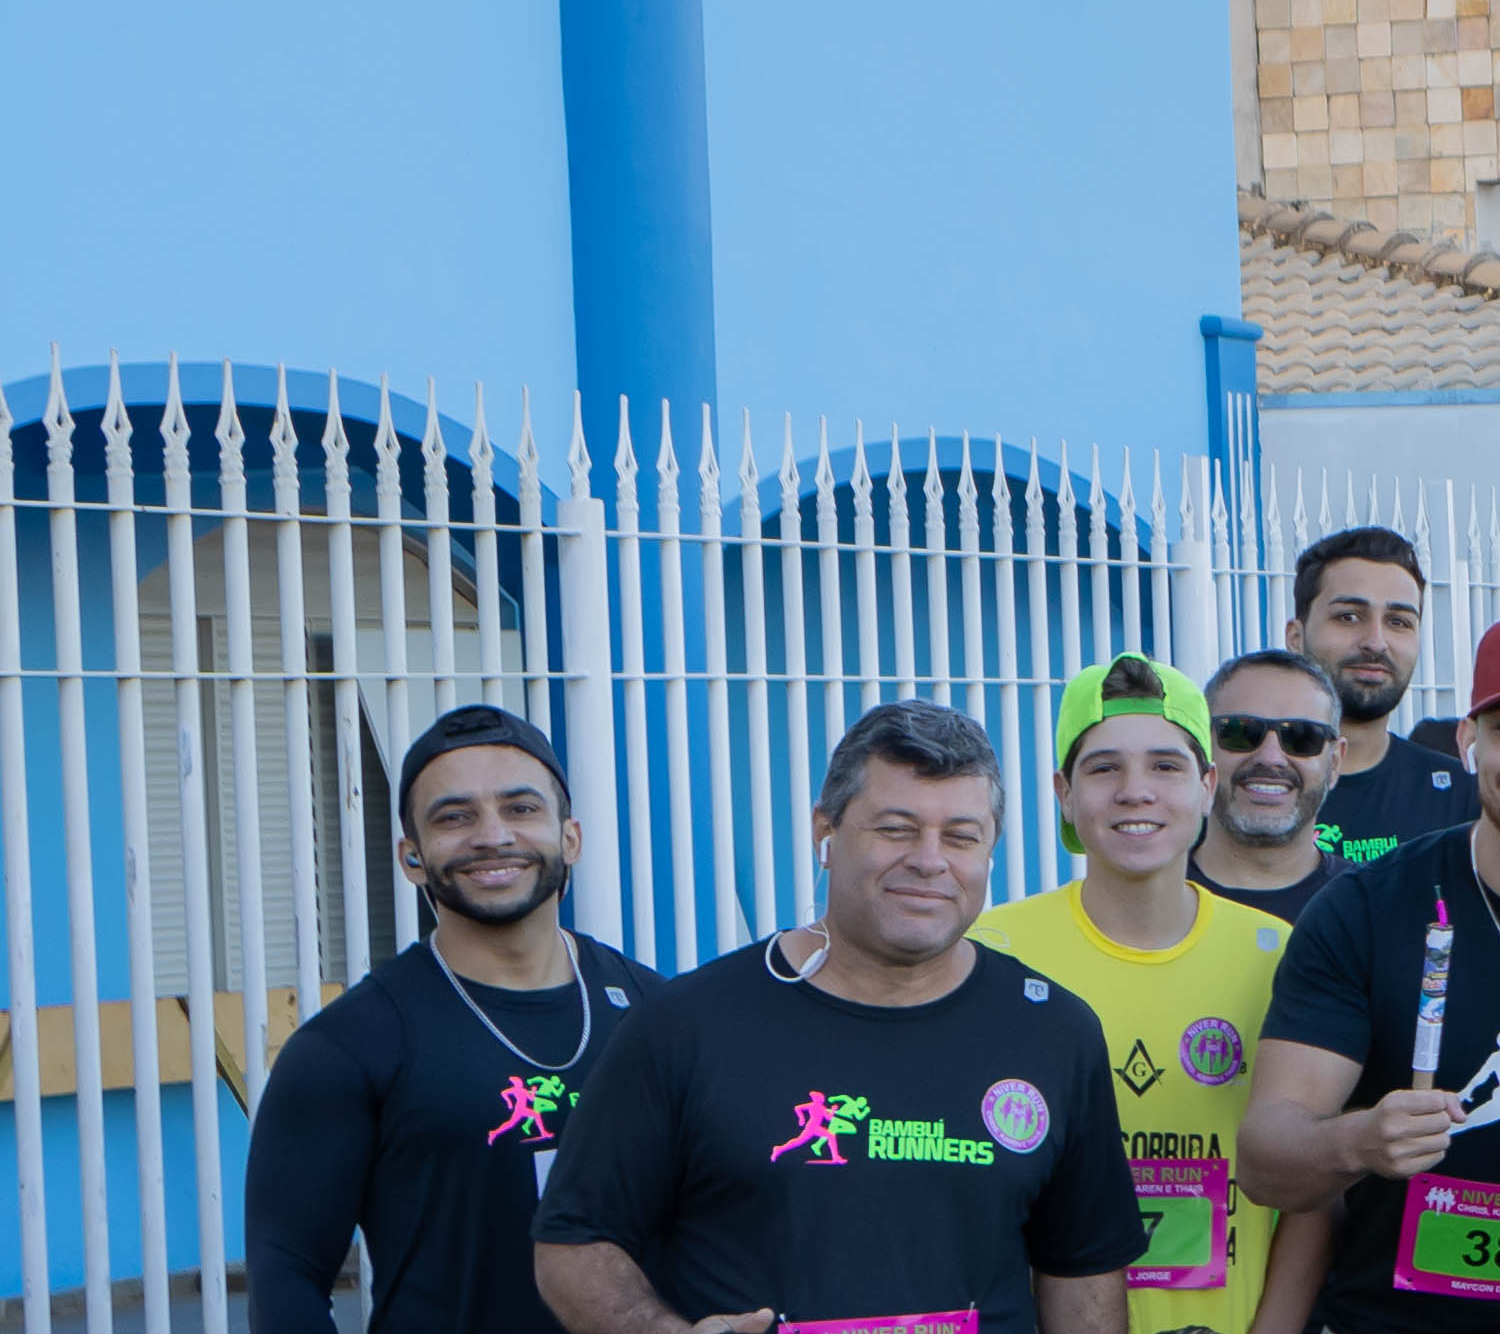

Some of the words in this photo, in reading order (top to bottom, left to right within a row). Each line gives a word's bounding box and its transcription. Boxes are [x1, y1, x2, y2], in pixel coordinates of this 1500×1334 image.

[869, 1118, 944, 1139] BAMBUÍ
[869, 1137, 994, 1165] RUNNERS
[1161, 1167, 1202, 1183] RUN
